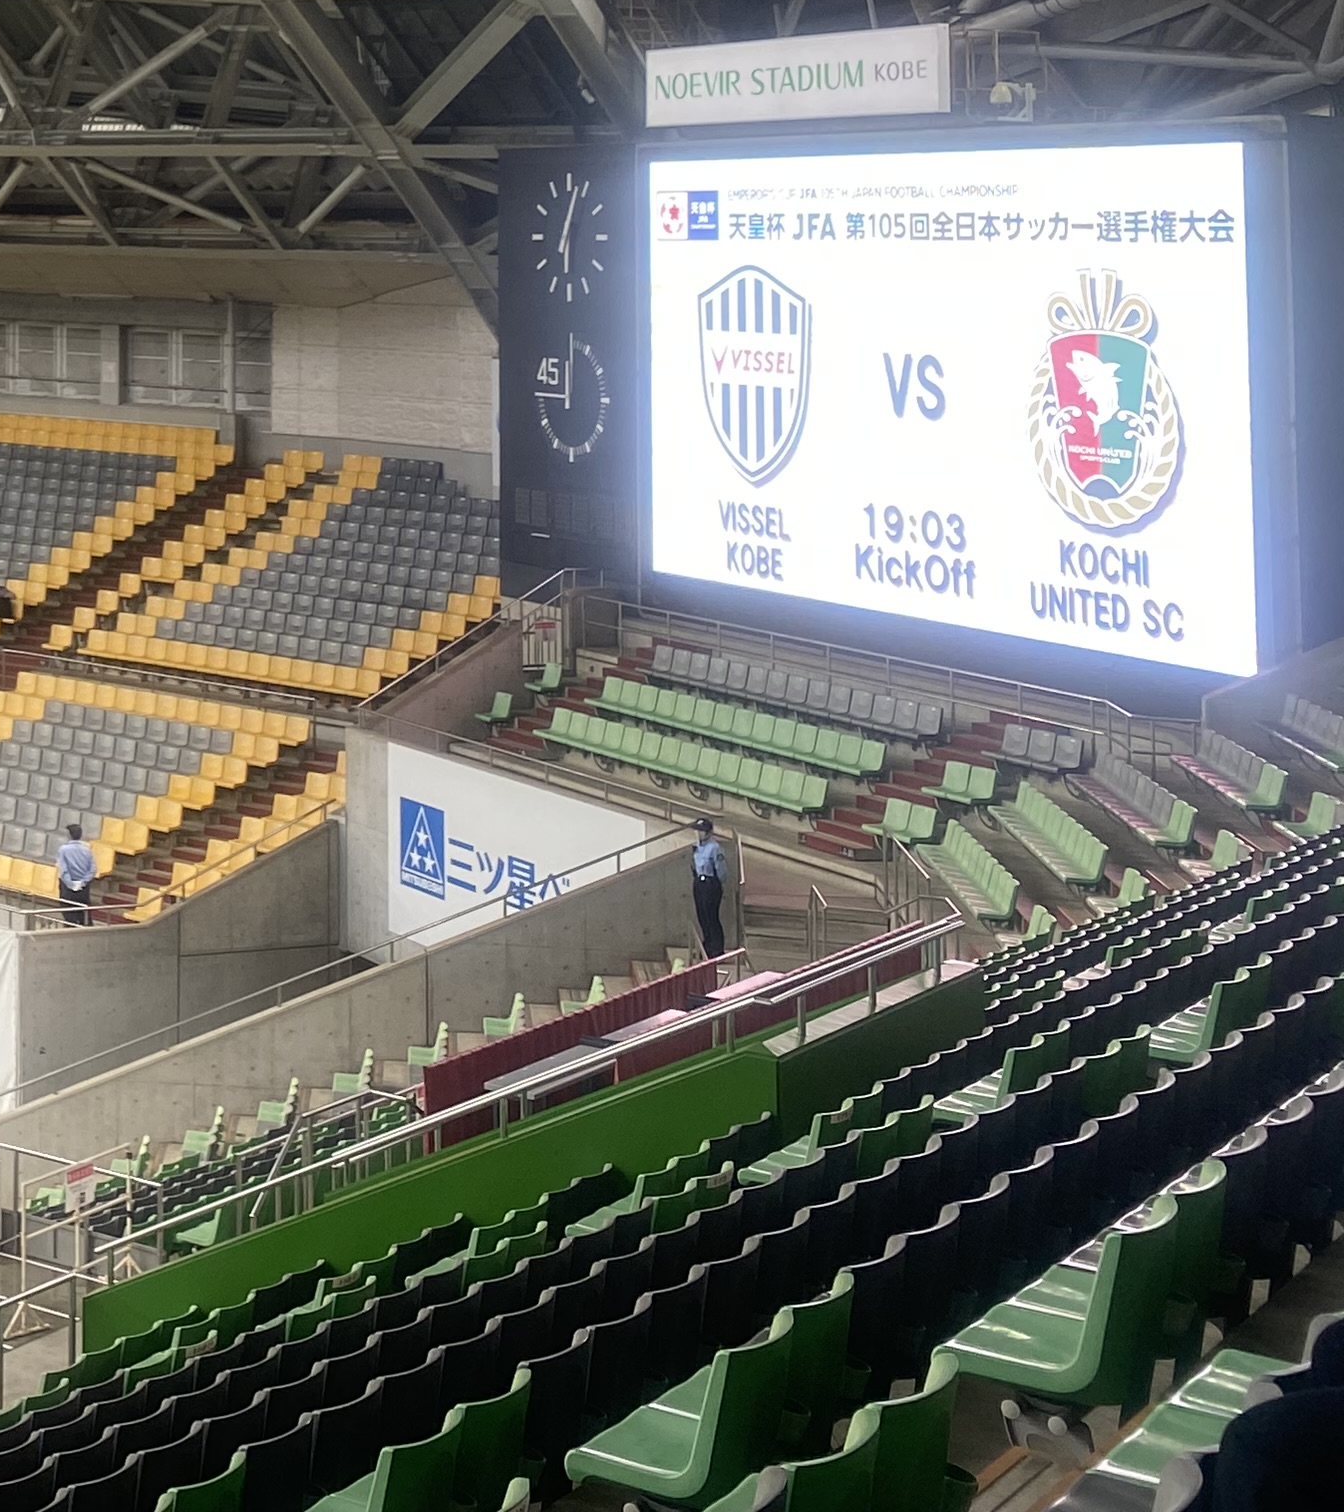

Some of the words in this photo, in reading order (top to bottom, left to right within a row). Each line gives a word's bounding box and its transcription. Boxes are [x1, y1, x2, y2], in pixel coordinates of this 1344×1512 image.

[655, 69, 742, 100] NOEVIR
[750, 59, 863, 95] STADIUM
[874, 59, 928, 83] KOBE
[728, 212, 785, 240] 天皇杯
[792, 213, 837, 241] JFA
[846, 208, 1235, 243] 第105回全日本サッカー選手権大会
[536, 356, 560, 386] 45
[732, 349, 795, 375] VISSEL
[882, 352, 946, 422] VS
[718, 499, 792, 542] VISSEL
[863, 502, 967, 553] 19:03
[726, 540, 784, 582] KOBE
[855, 543, 977, 600] KickOff
[1059, 539, 1150, 589] KOCHI
[1029, 580, 1131, 633] UNITED
[1142, 598, 1185, 642] SC
